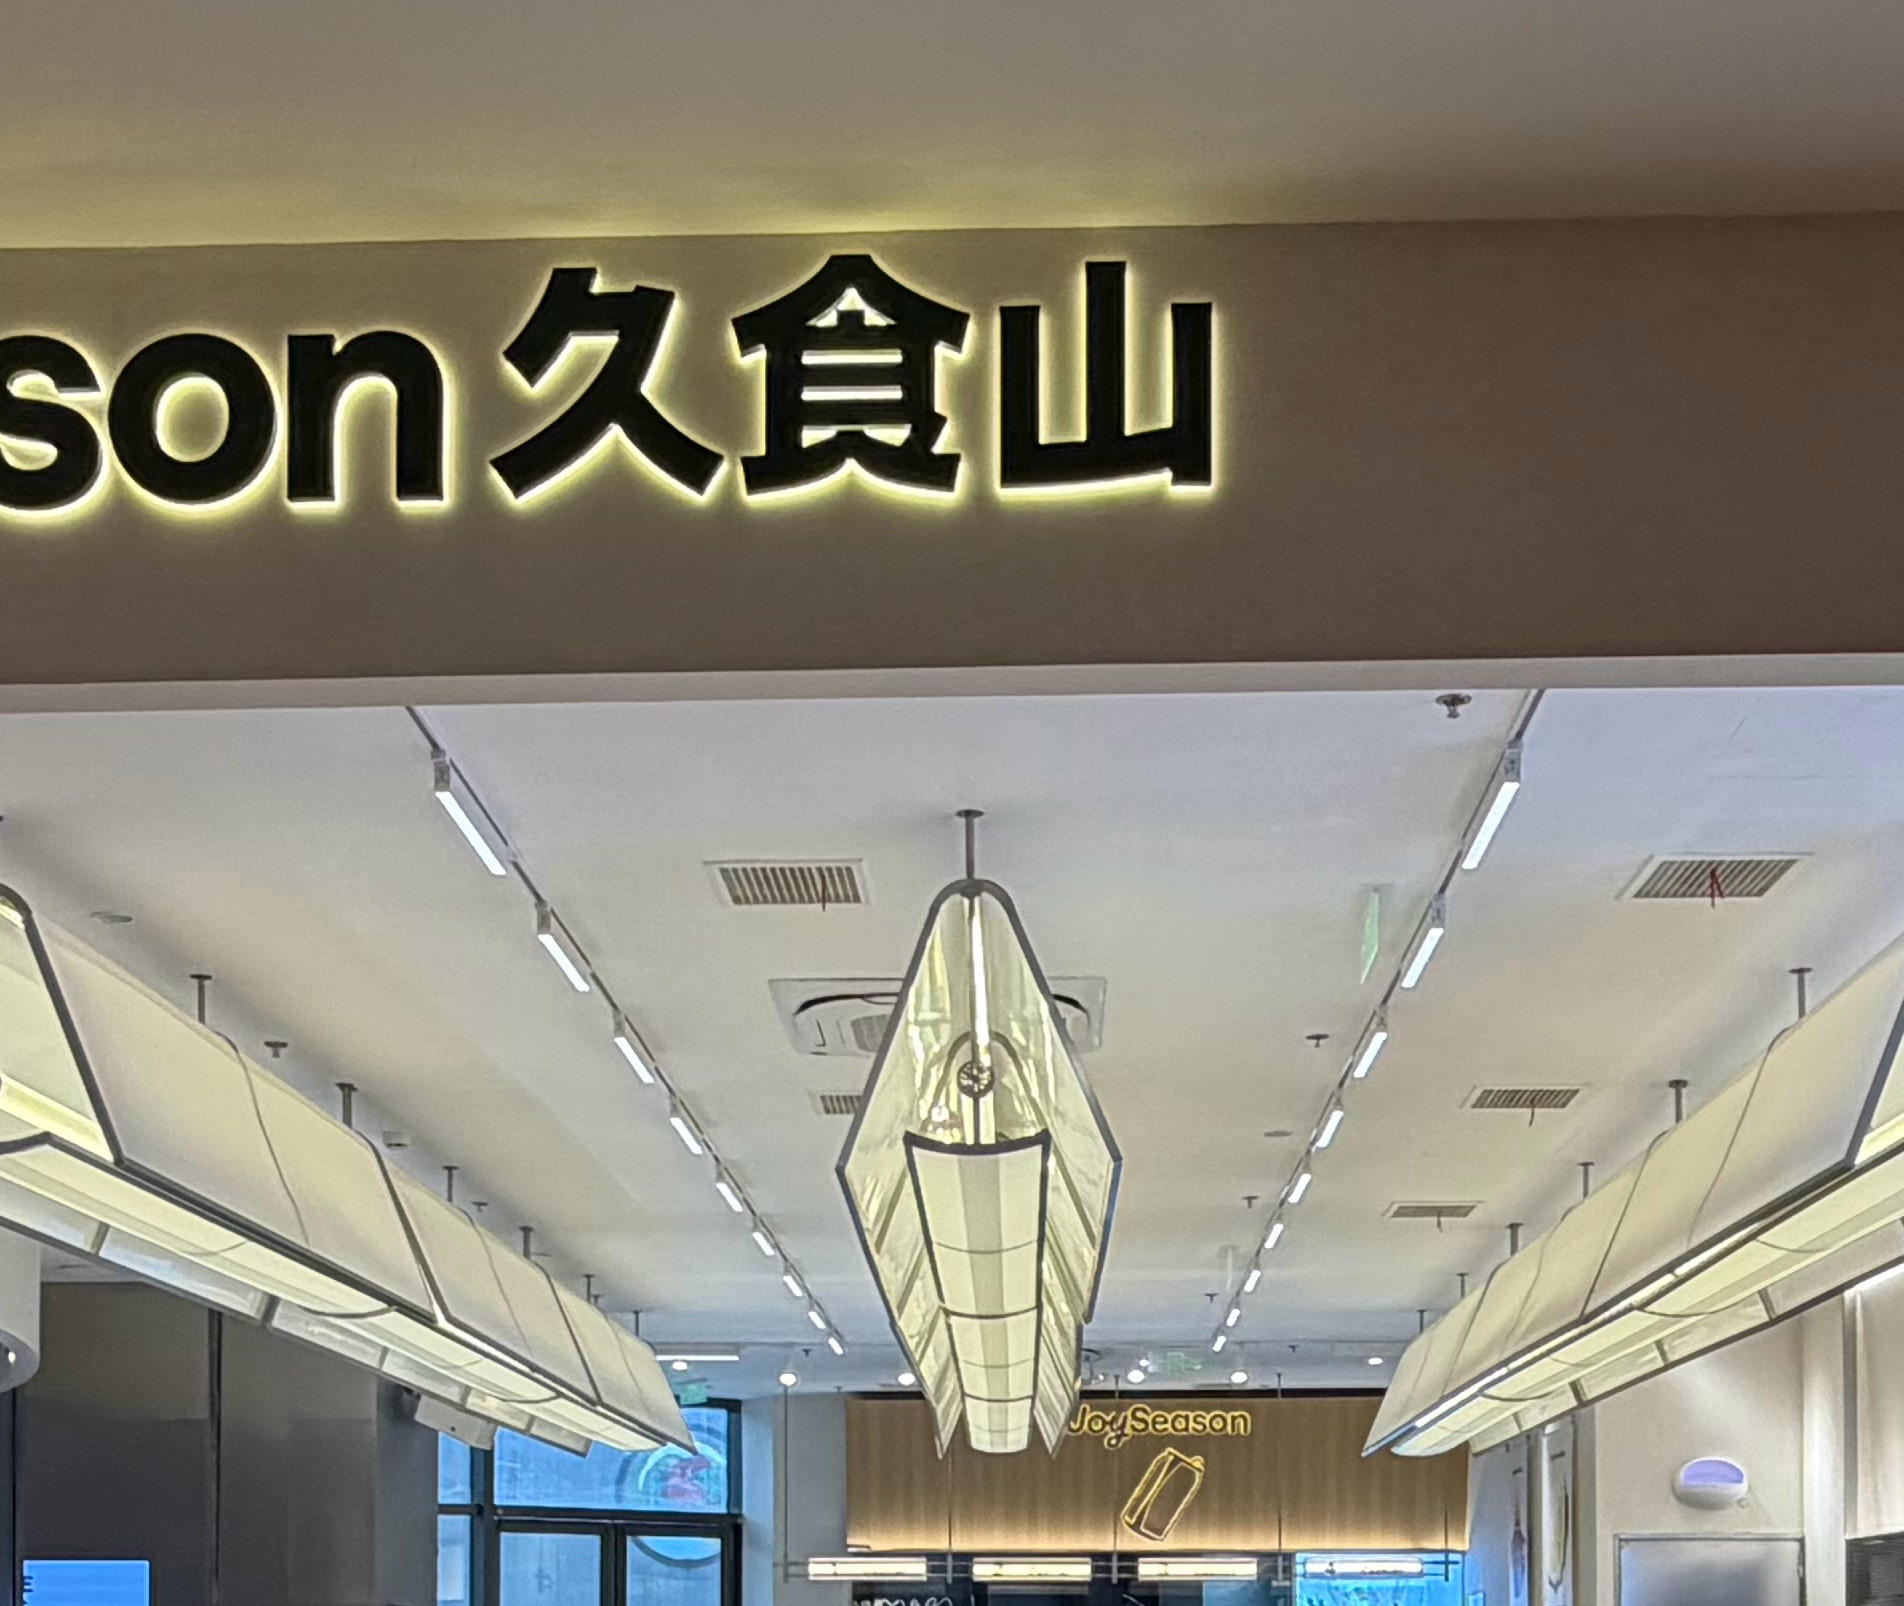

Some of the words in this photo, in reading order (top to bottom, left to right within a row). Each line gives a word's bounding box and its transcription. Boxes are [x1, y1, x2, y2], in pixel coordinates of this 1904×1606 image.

[491, 254, 1213, 498] 久食山
[1068, 1404, 1251, 1449] JoySeason
